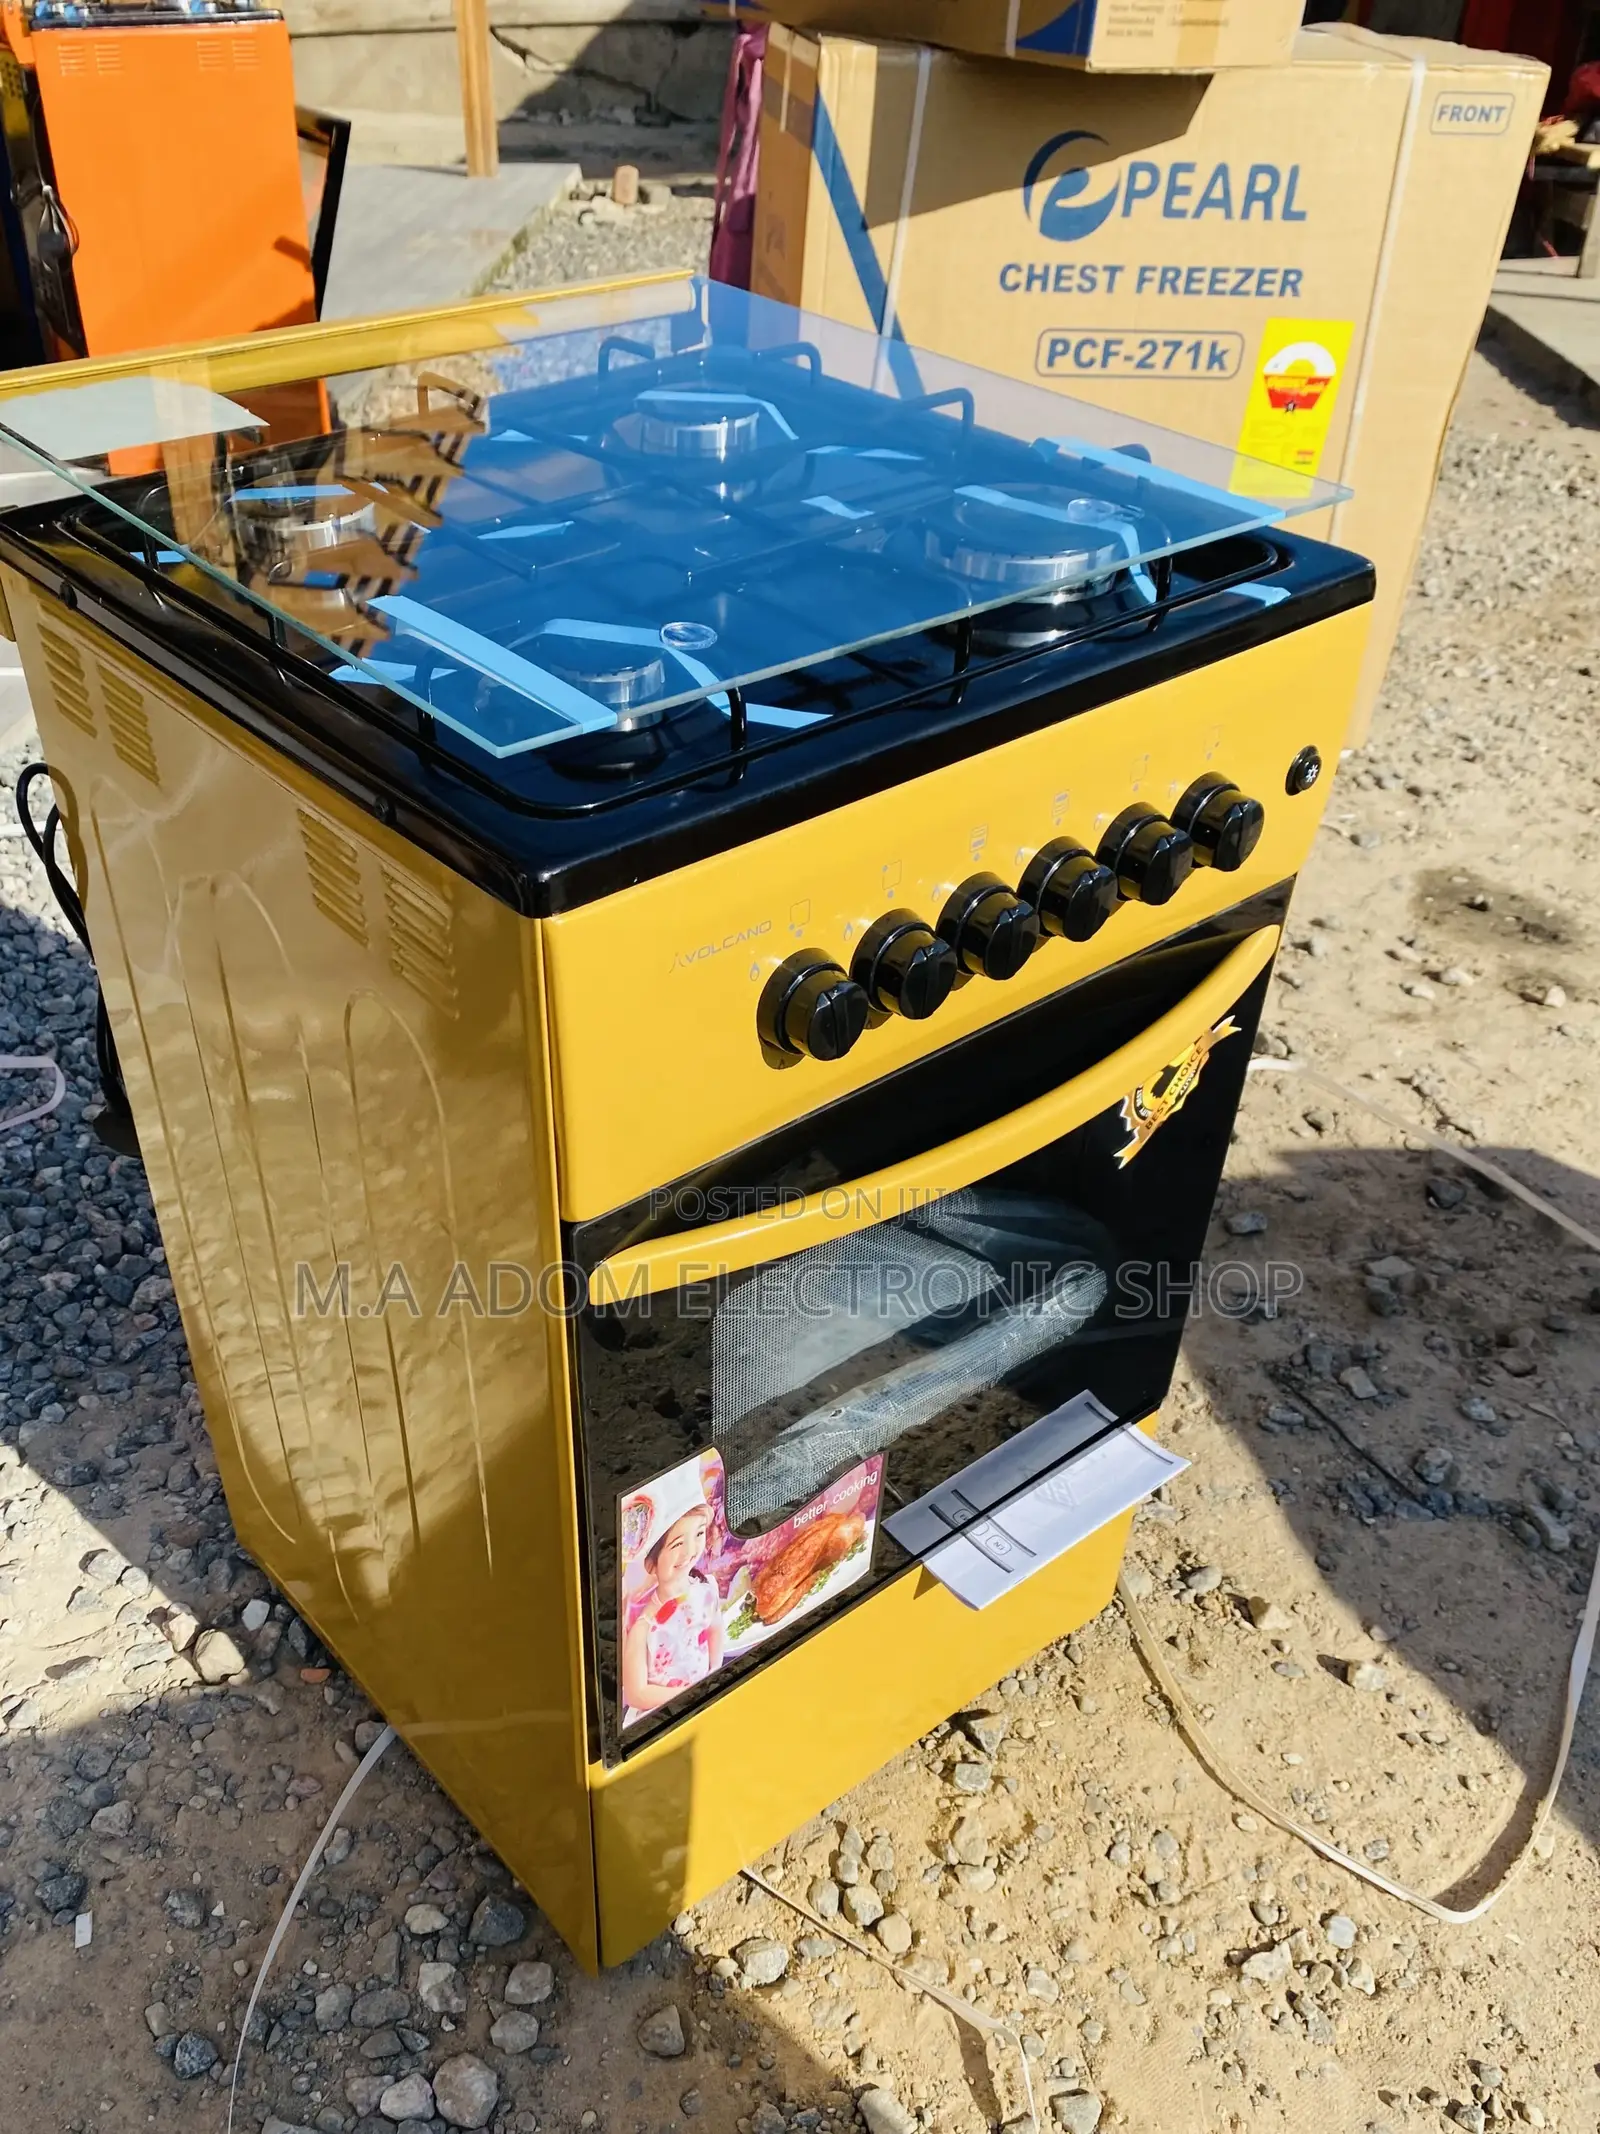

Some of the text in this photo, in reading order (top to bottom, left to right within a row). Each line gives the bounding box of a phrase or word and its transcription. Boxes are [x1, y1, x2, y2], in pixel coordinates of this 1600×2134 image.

[1437, 104, 1506, 123] FRONT
[1121, 161, 1307, 221] PEARL
[1000, 263, 1304, 297] CHEST FREEZER
[1046, 338, 1230, 371] PCF-271k
[685, 920, 772, 964] VOLCANO
[1145, 1046, 1204, 1130] BEST CHOICE
[793, 1471, 878, 1529] better cooking
